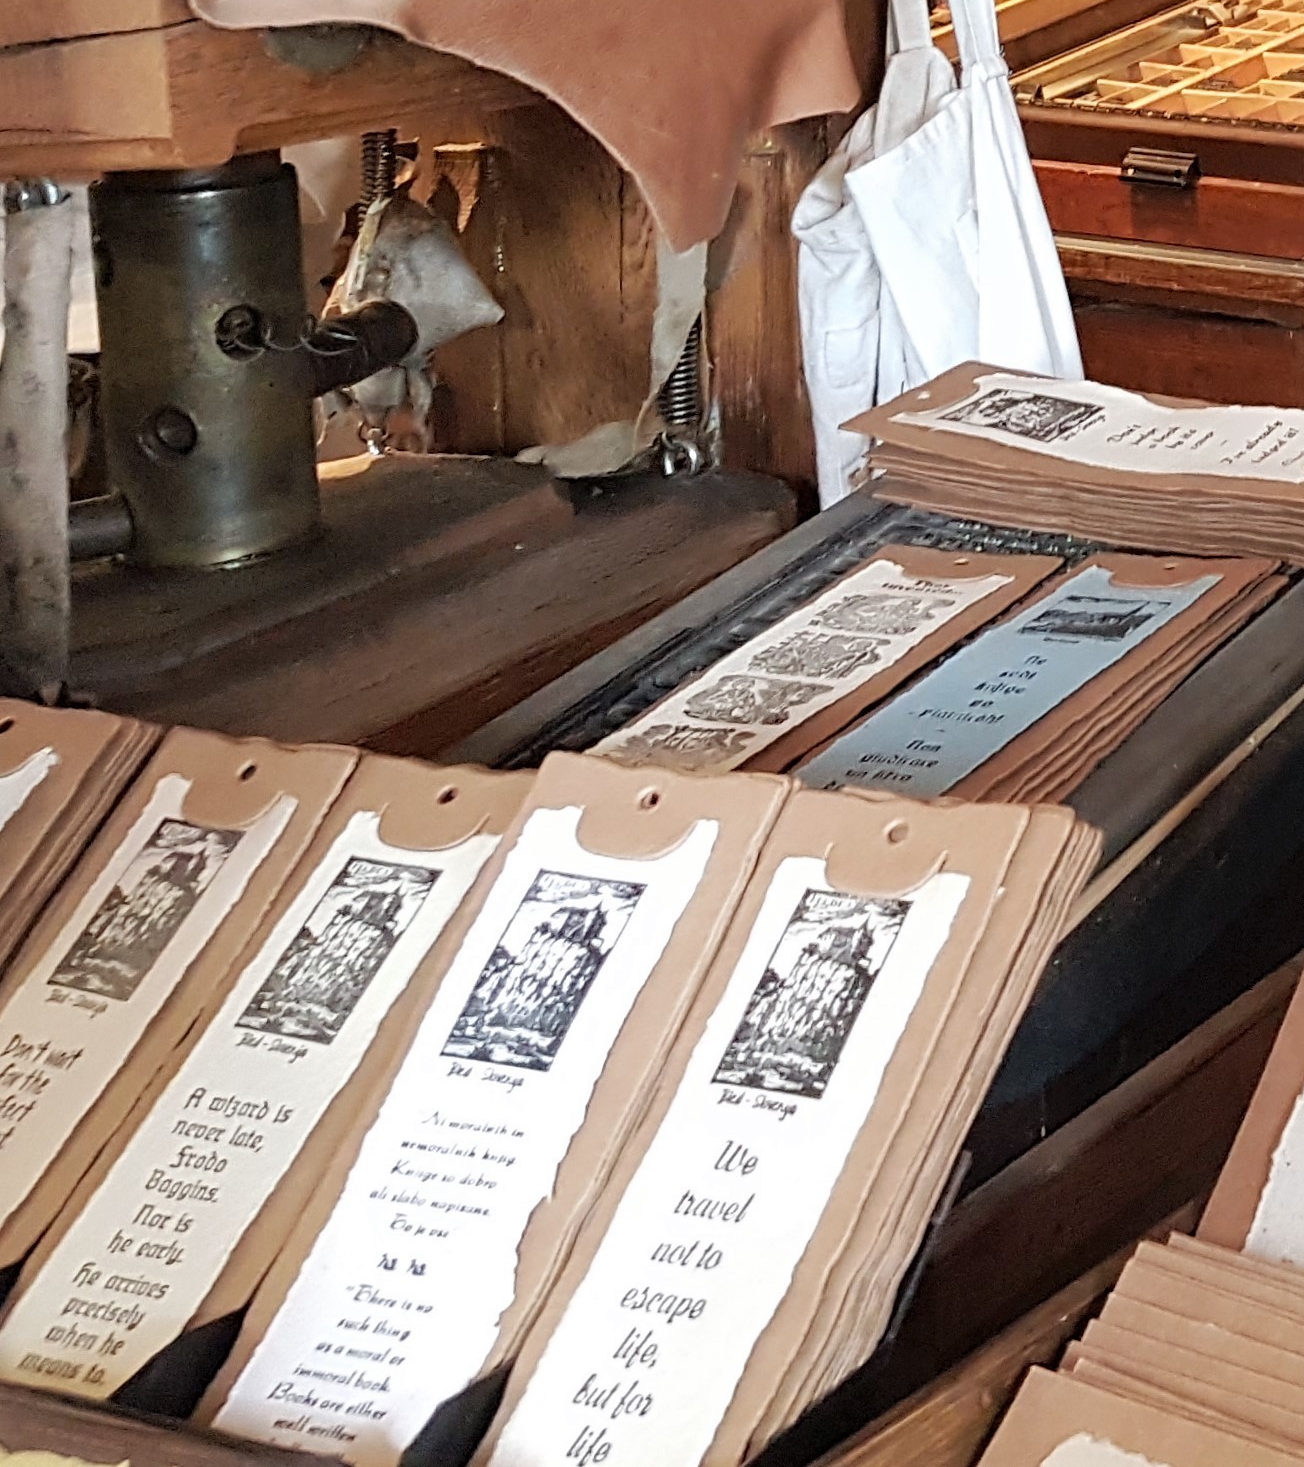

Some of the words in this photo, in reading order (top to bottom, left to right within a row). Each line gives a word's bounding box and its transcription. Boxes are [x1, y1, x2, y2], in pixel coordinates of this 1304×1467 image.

[184, 1087, 206, 1111] A
[208, 1095, 270, 1120] wizard
[273, 1104, 293, 1124] is
[171, 1120, 226, 1144] never
[229, 1125, 264, 1153] late,
[714, 1140, 759, 1175] We
[145, 1169, 219, 1203] Baggins.
[132, 1204, 170, 1229] Nor
[175, 1213, 194, 1233] is
[673, 1190, 756, 1224] travel
[107, 1230, 133, 1254] he
[650, 1240, 697, 1268] not
[696, 1242, 723, 1270] to
[104, 1274, 170, 1299] arrives
[61, 1297, 146, 1331] precisely
[620, 1286, 707, 1325] escape
[44, 1322, 99, 1351] when
[100, 1331, 125, 1356] he
[337, 1316, 371, 1331] such
[373, 1319, 411, 1342] thing
[346, 1348, 391, 1363] moral
[612, 1327, 659, 1369] life,
[17, 1353, 84, 1379] means
[293, 1363, 357, 1385] immoral
[267, 1381, 318, 1407] Books
[320, 1400, 342, 1413] are
[345, 1401, 387, 1420] either
[572, 1373, 620, 1411] but
[611, 1381, 654, 1420] for
[566, 1424, 613, 1466] life
